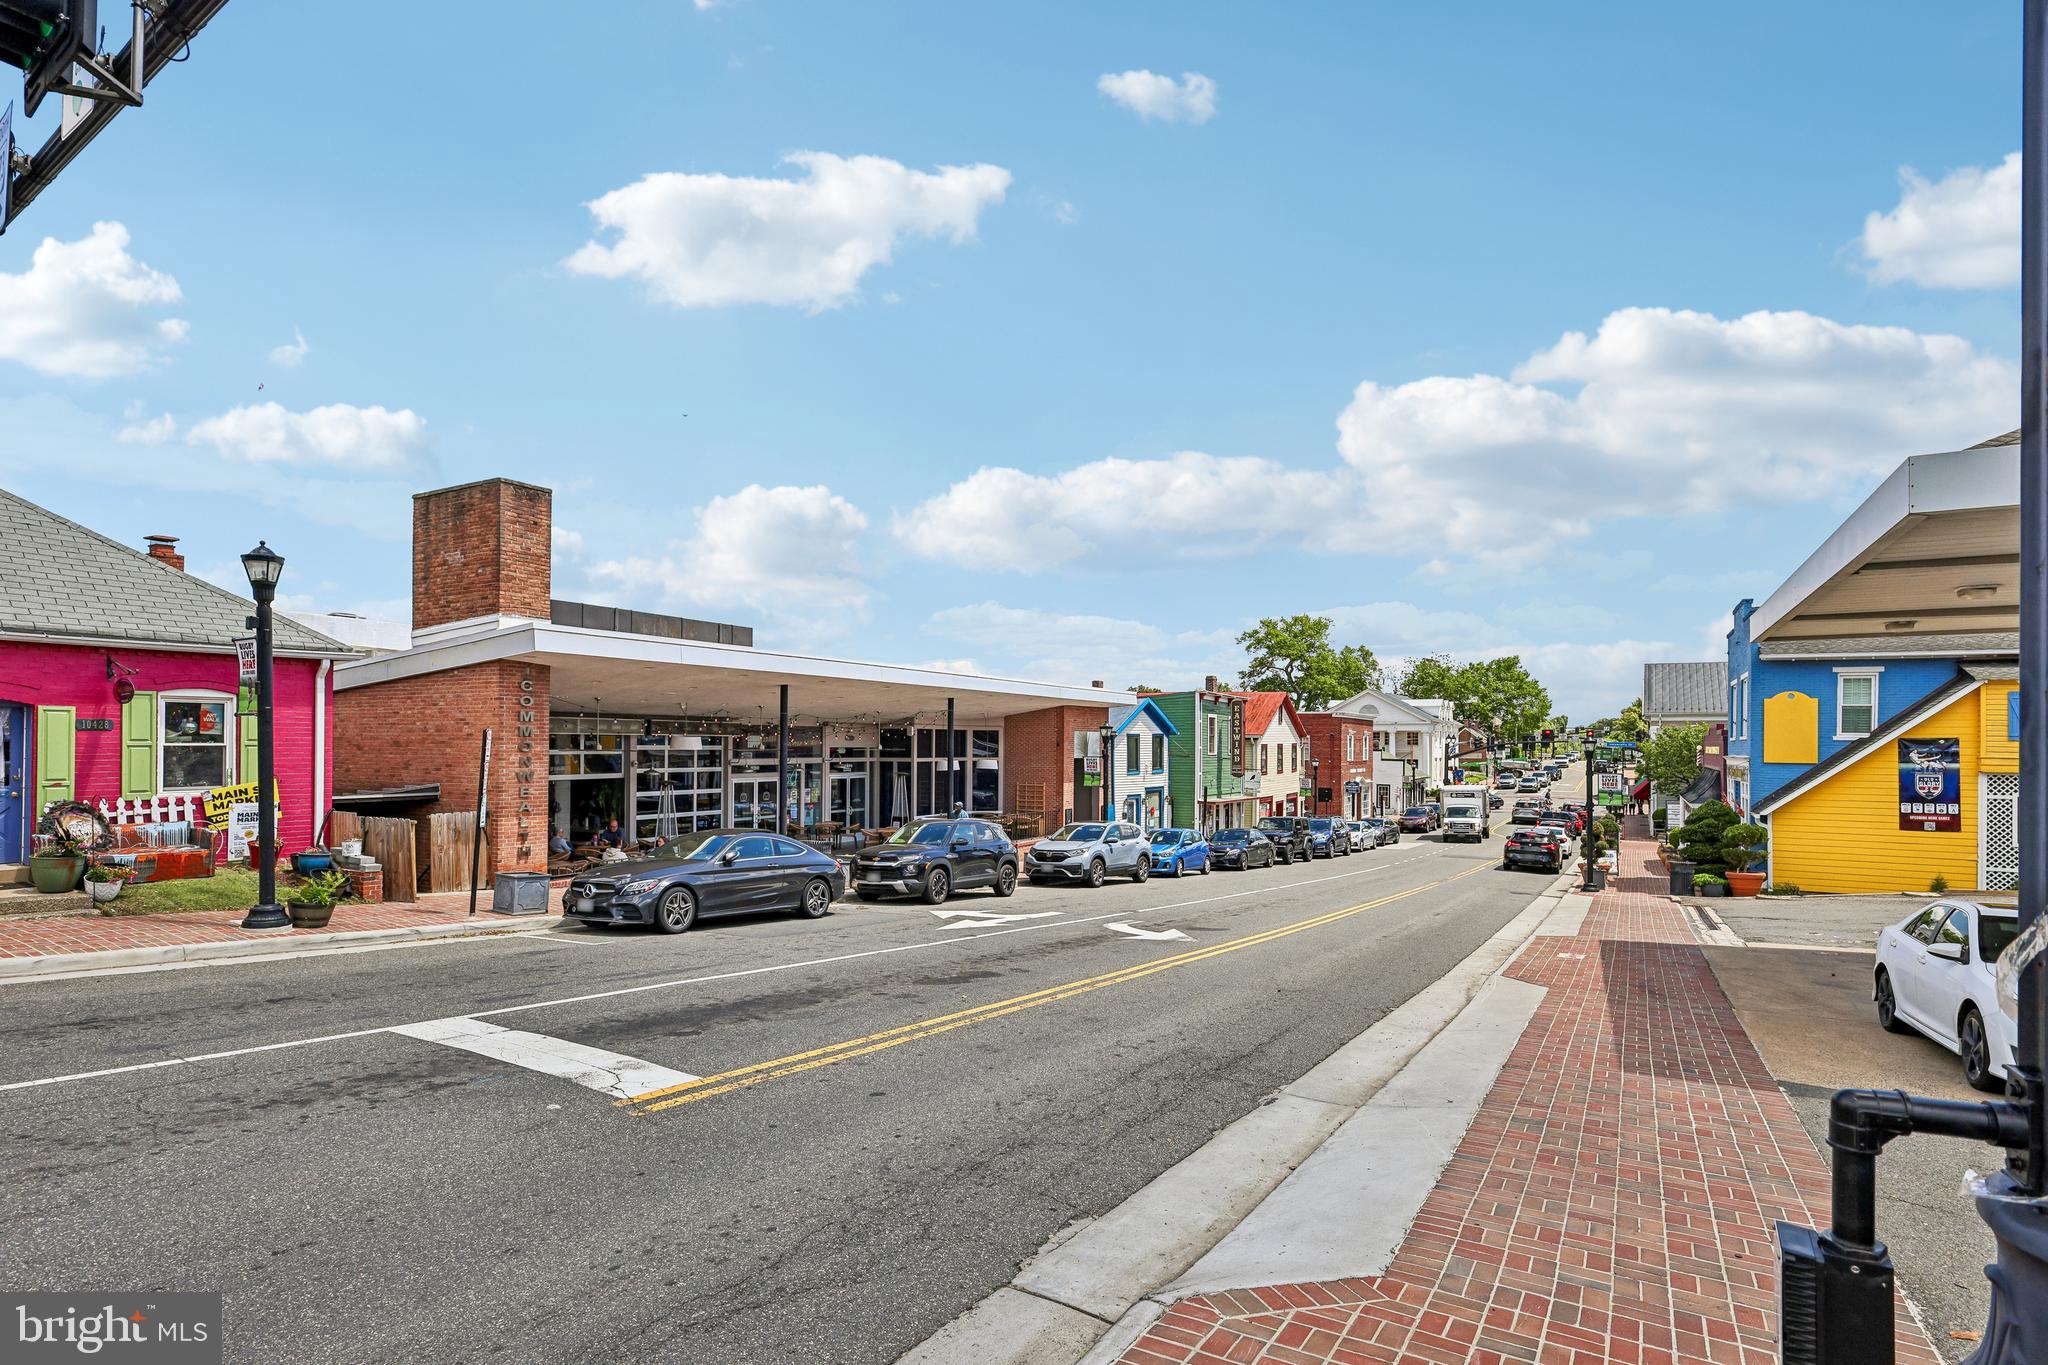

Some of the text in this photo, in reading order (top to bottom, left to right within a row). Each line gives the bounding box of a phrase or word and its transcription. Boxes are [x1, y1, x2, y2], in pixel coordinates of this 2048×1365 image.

[239, 642, 254, 650] RUGBY
[240, 650, 256, 660] LIVES
[242, 659, 256, 670] HERE
[81, 719, 109, 729] 10428
[1233, 705, 1241, 762] EASTWIND
[516, 680, 535, 865] COMMONWEALTH
[211, 786, 259, 802] MAIN S
[212, 795, 259, 811] MARK
[210, 814, 229, 823] TOD
